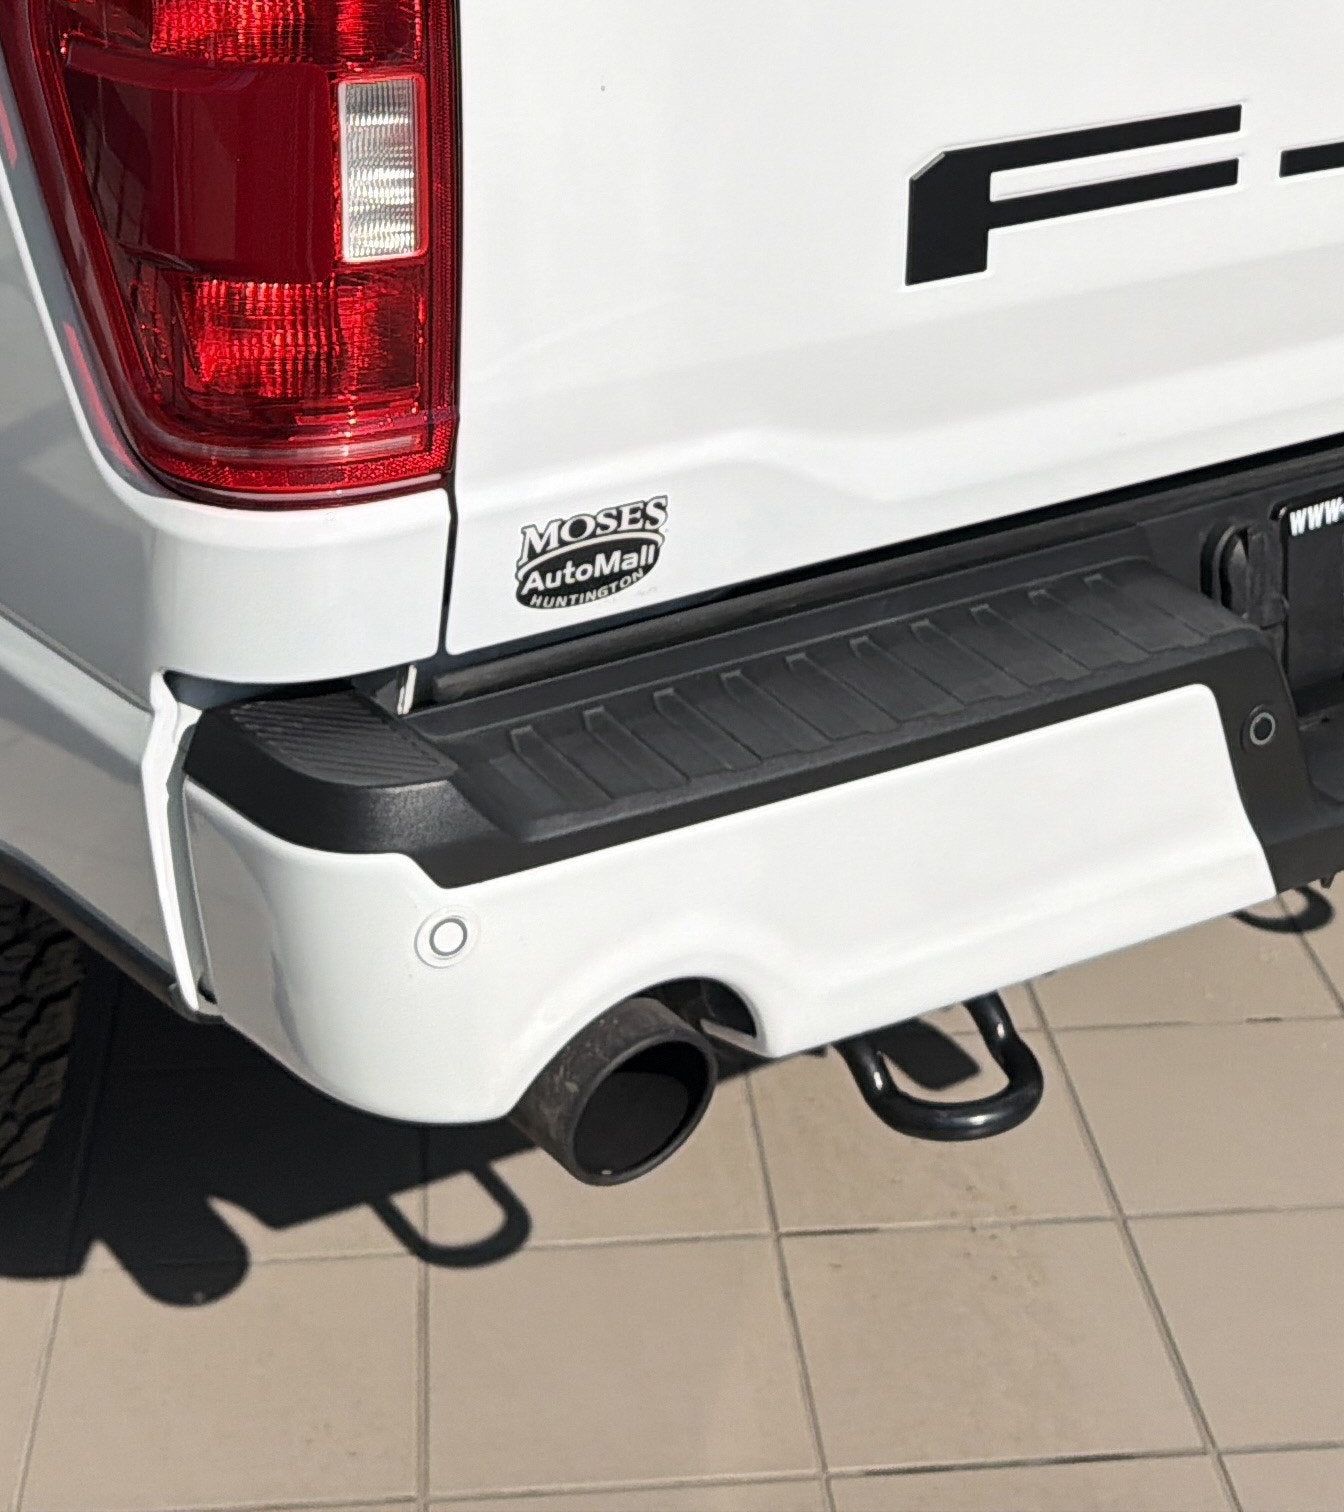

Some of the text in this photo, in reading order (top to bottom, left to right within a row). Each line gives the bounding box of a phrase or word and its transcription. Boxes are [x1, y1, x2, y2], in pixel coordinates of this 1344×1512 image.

[517, 495, 668, 567] MOSES
[521, 544, 656, 595] AutoMall
[530, 568, 644, 608] HUNTINGTON
